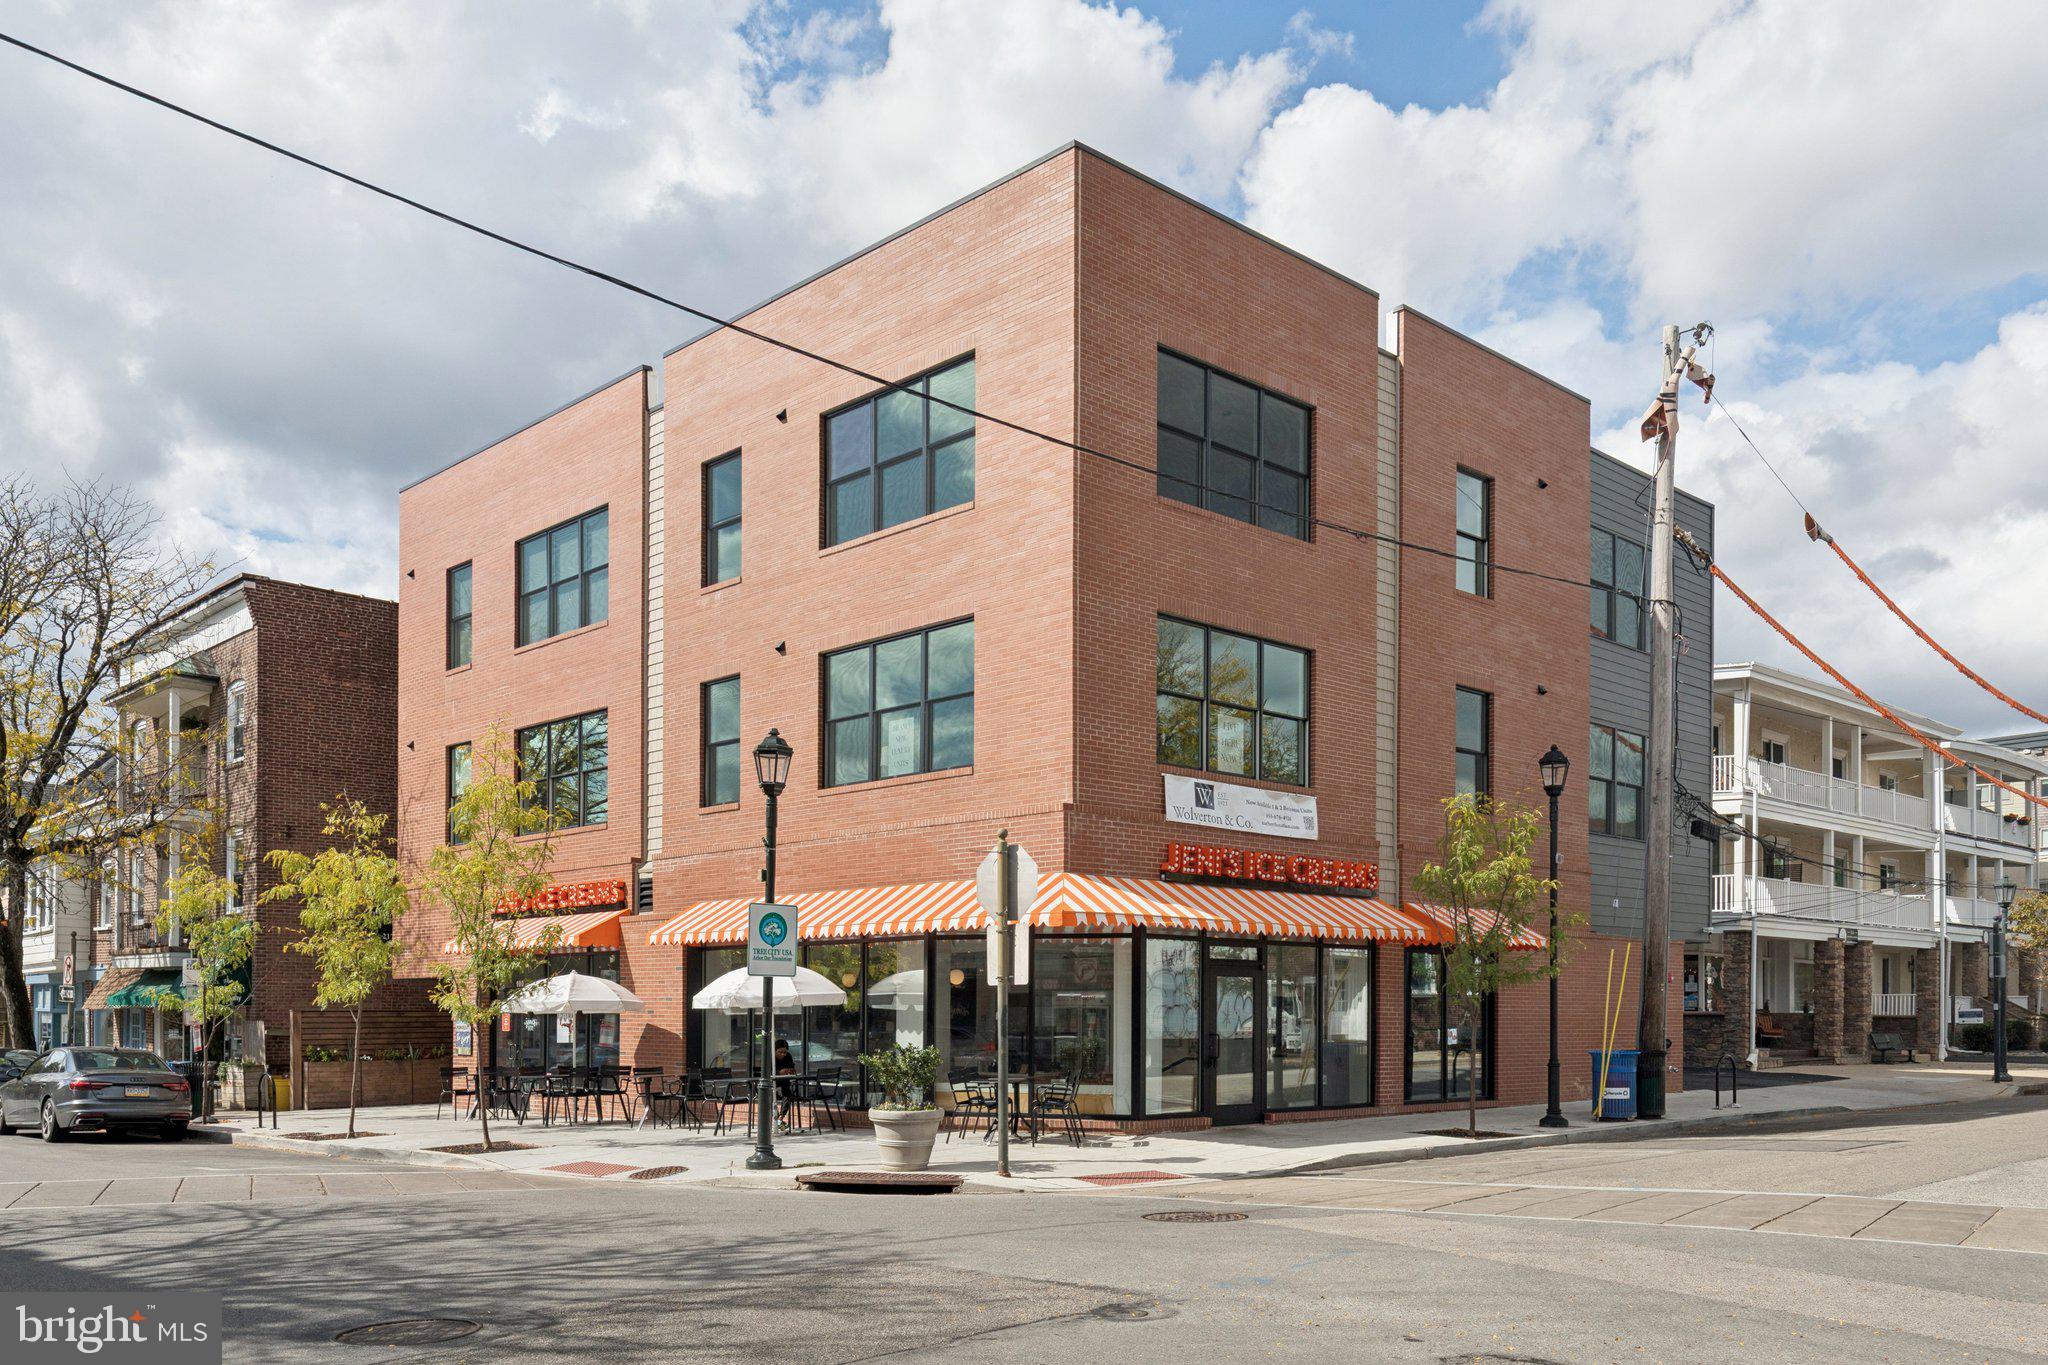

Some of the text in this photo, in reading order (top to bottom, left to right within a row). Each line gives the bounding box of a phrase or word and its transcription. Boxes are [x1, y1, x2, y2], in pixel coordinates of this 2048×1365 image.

[1172, 805, 1223, 825] Wolverton
[1224, 814, 1234, 827] &
[1236, 814, 1254, 829] Co.
[1244, 849, 1287, 882] ICE
[1286, 855, 1378, 889] CREAMS
[559, 879, 625, 908] CREAMS
[753, 947, 767, 955] TREE
[768, 948, 781, 956] CITY
